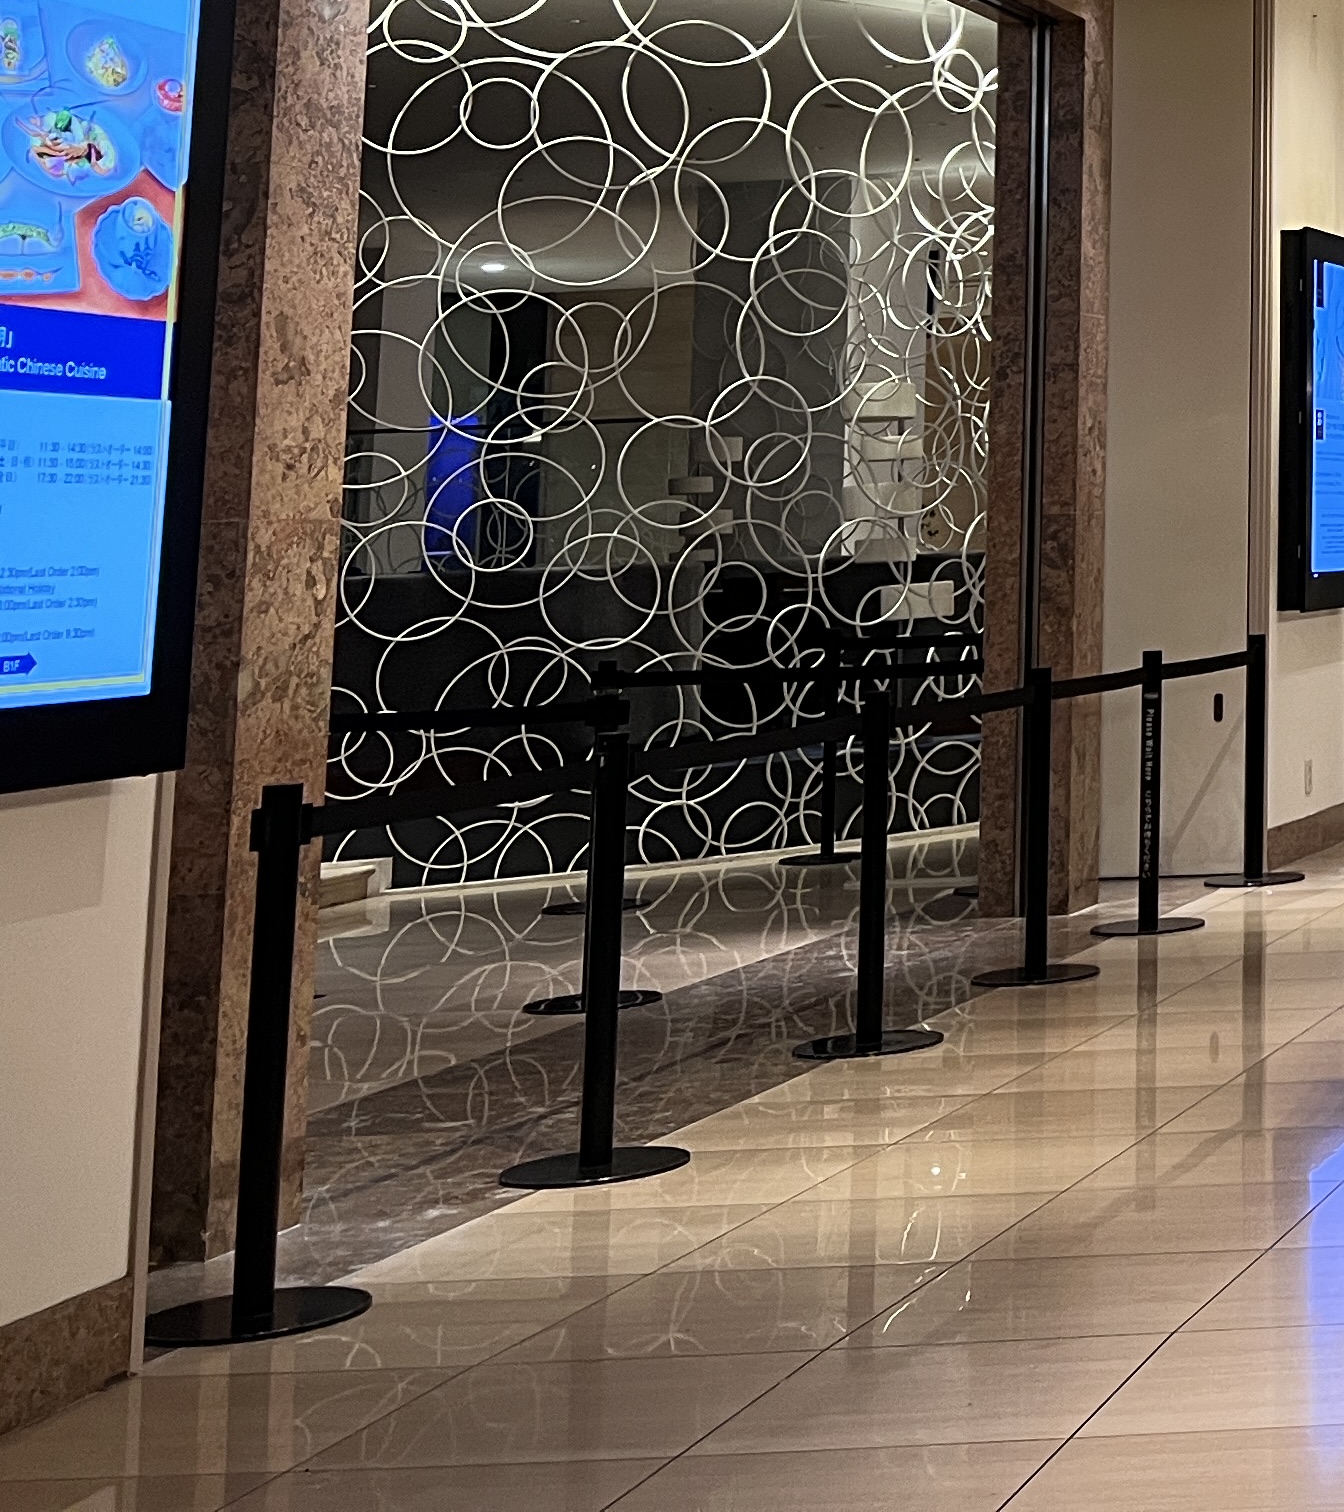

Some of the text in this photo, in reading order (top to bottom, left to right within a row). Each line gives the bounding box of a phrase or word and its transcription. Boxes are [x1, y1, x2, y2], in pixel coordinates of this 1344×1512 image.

[17, 357, 62, 376] Chinese
[66, 361, 106, 379] Cuisine
[1146, 709, 1154, 736] Please
[1145, 739, 1153, 758] Wait
